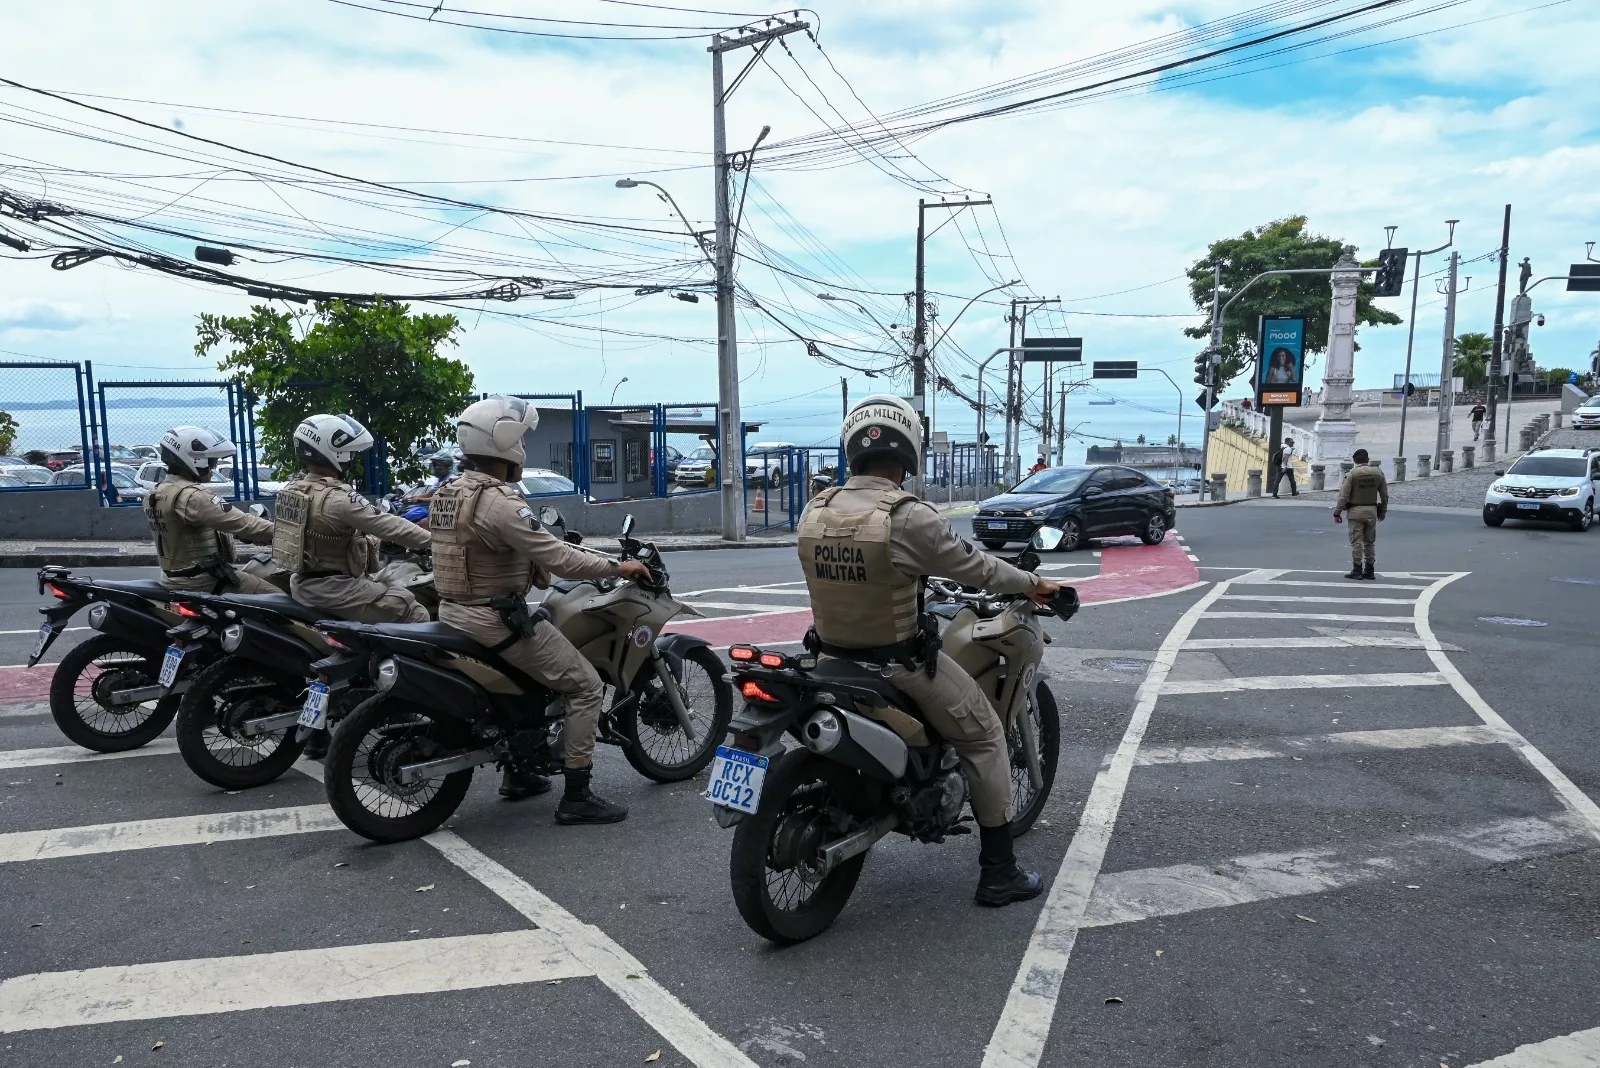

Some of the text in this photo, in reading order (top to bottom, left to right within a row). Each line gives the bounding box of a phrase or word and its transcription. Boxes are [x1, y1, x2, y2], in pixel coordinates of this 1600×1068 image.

[1269, 331, 1297, 340] mood
[873, 408, 912, 432] MILITAR
[430, 513, 454, 528] MILITAR
[814, 542, 865, 564] POLÍCIA
[815, 562, 867, 582] MILITAR
[731, 753, 751, 765] BRASIL
[721, 760, 755, 786] RCX
[712, 779, 754, 808] 0C12
